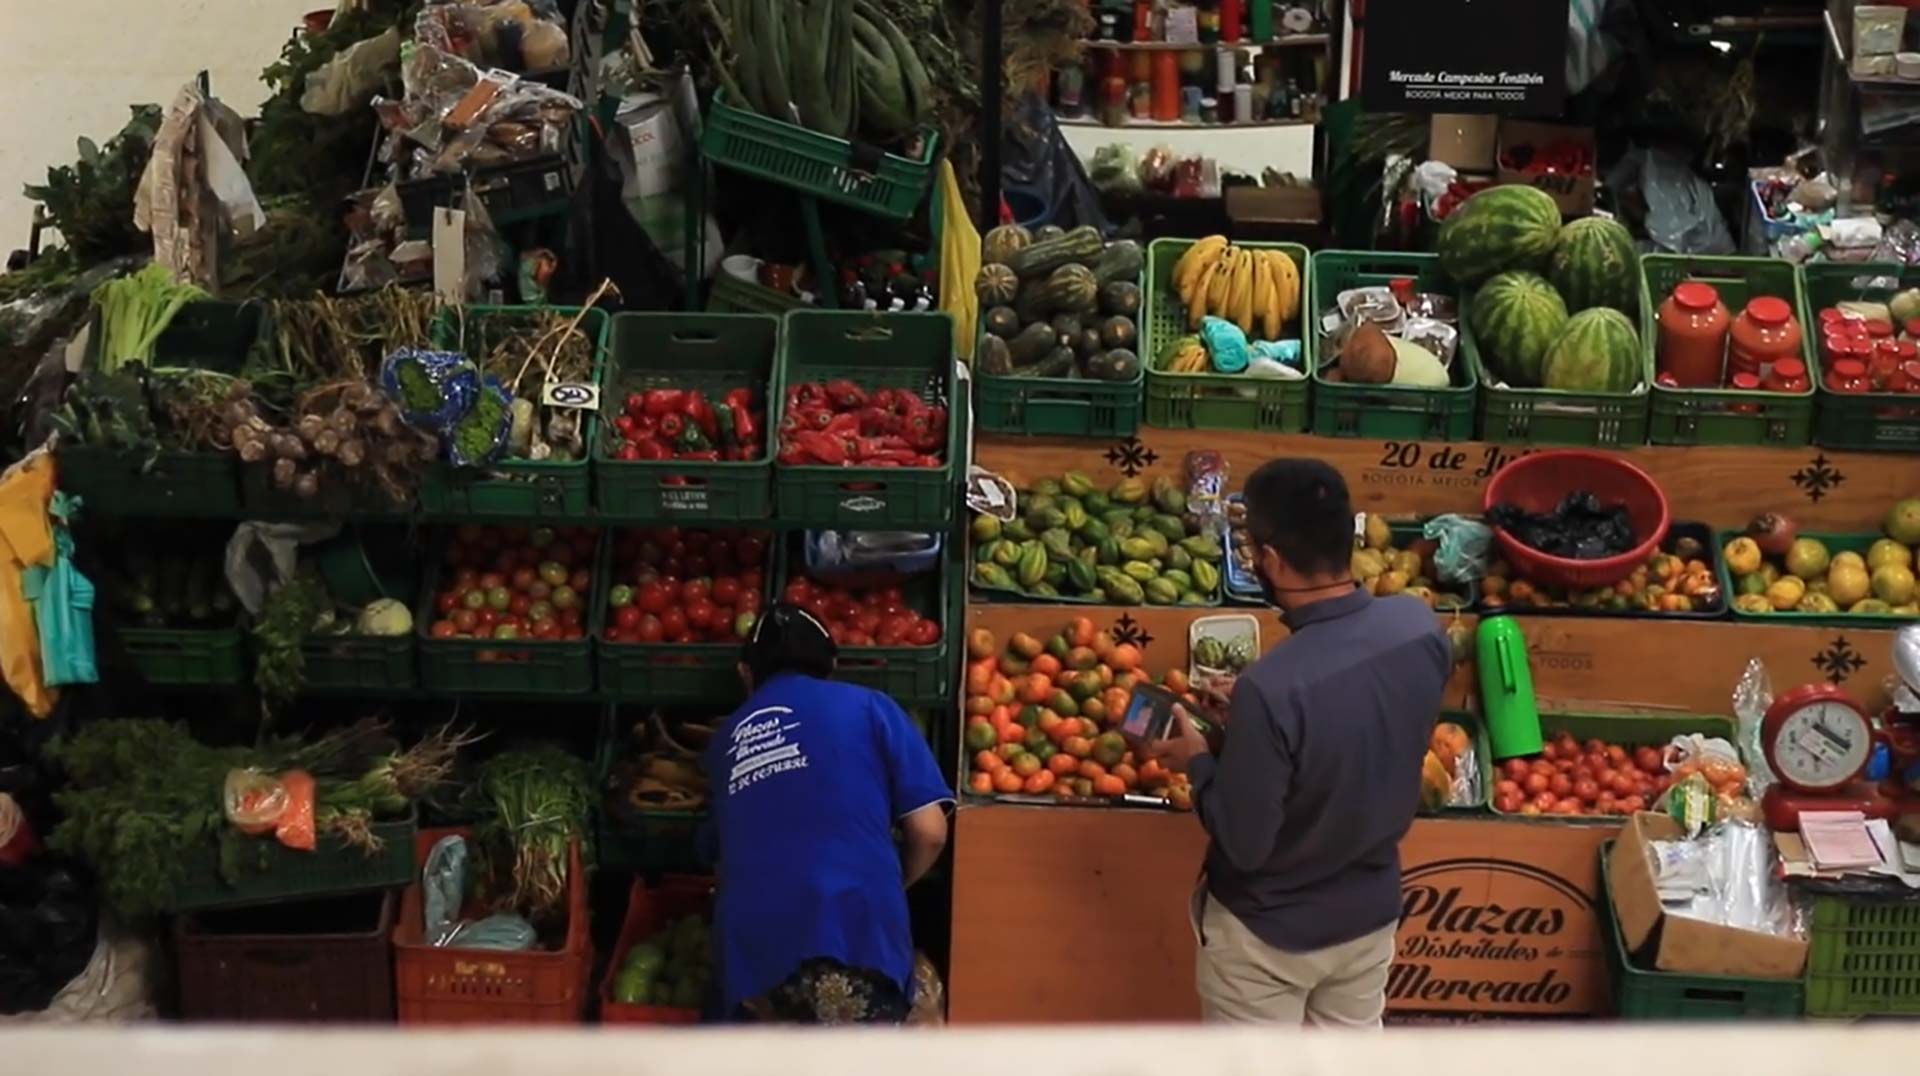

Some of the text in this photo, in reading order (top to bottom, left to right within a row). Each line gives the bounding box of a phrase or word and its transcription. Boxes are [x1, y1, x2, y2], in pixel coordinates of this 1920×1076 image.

[1388, 70, 1544, 86] Mercado Campesino Fontibón
[1443, 91, 1471, 100] MEJOR
[1472, 92, 1493, 100] PARA
[1495, 92, 1525, 101] TODOS
[1380, 441, 1421, 469] 20
[1428, 446, 1466, 470] de
[1398, 885, 1564, 935] Plazas
[1398, 936, 1538, 961] Distritales
[1384, 963, 1571, 1004] Mercado
